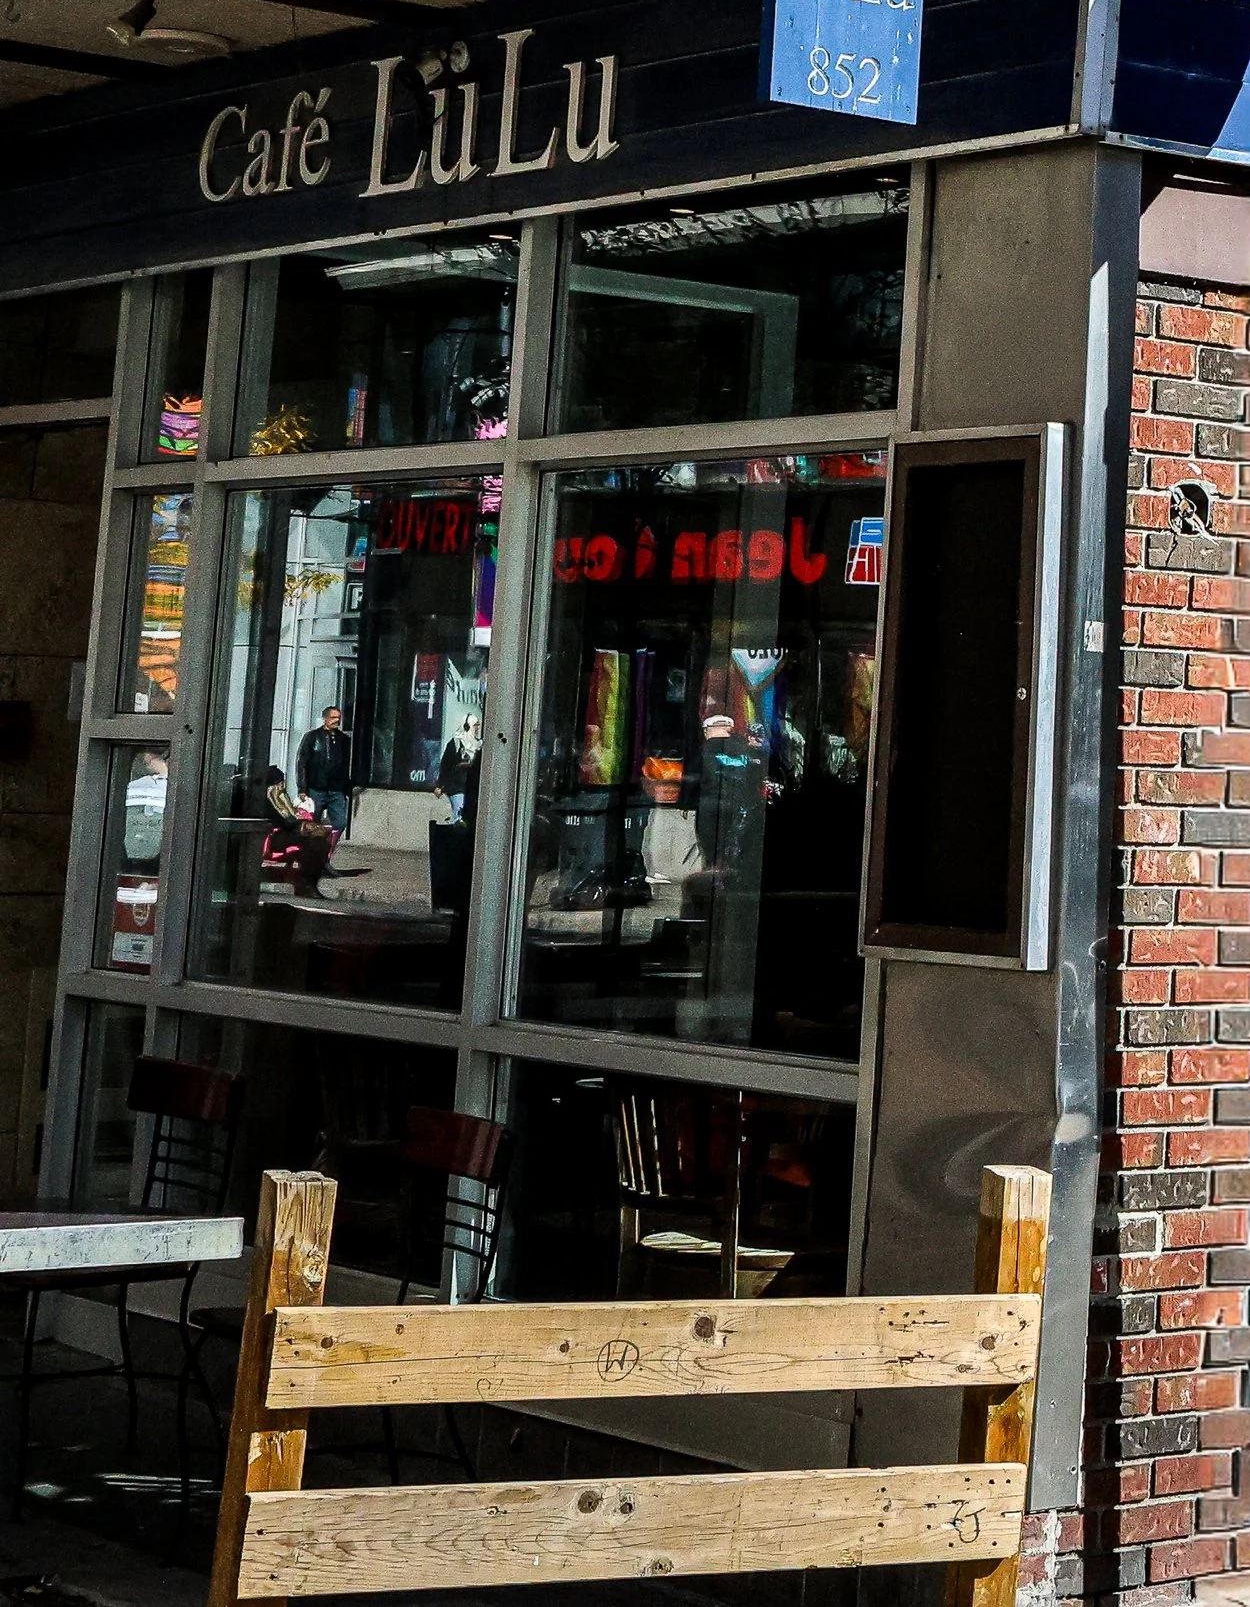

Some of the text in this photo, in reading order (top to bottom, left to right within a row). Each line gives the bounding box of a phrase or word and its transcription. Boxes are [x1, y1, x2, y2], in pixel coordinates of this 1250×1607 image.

[807, 47, 880, 103] 852
[199, 86, 333, 203] Café
[376, 499, 477, 553] OUVERT
